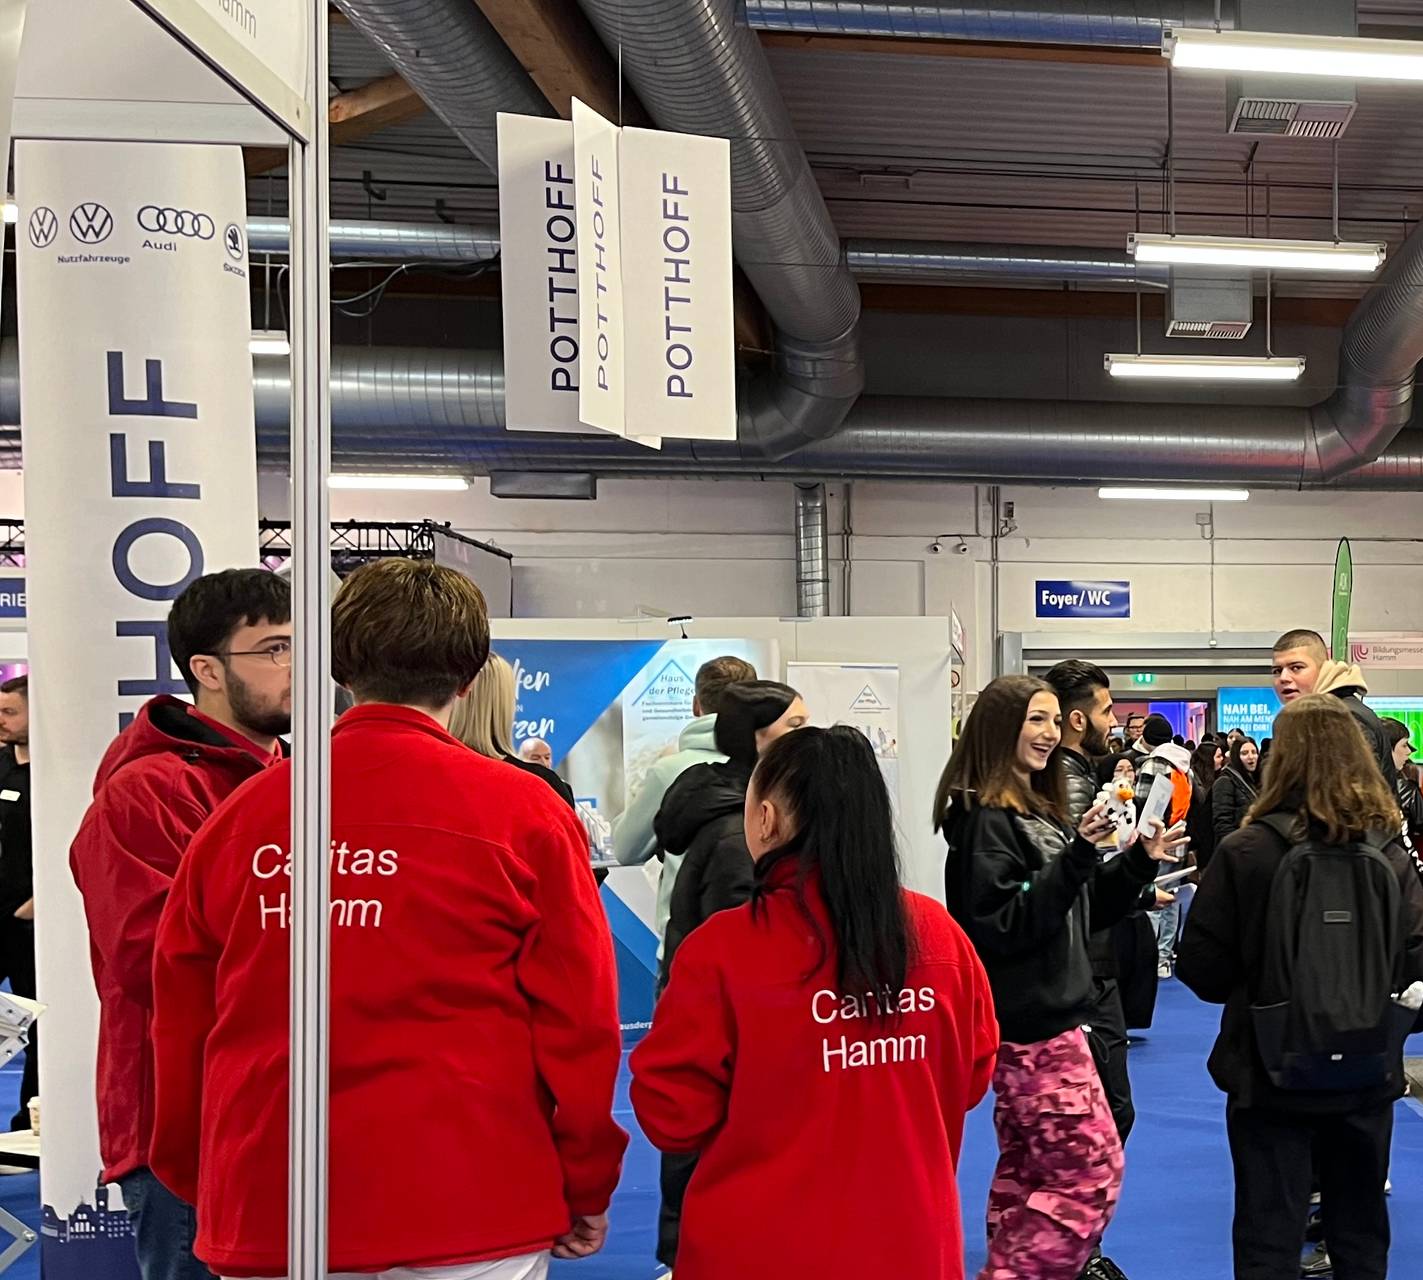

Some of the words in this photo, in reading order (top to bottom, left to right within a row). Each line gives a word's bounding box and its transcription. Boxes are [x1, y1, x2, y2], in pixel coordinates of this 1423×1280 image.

[218, 0, 256, 39] amm
[57, 254, 130, 264] Nutzfahrzeuge
[142, 239, 177, 252] Audi
[545, 160, 579, 392] POTTHOFF
[591, 154, 609, 391] POTTHOFF
[661, 172, 693, 398] POTTHOFF
[107, 351, 204, 734] HOFF
[1372, 645, 1423, 656] Bildungsmesse
[648, 687, 665, 695] der
[660, 674, 684, 683] Haus
[1223, 703, 1248, 715] NAH
[252, 840, 399, 880] Citas
[259, 892, 383, 931] Hmm
[822, 1034, 926, 1072] Hamm
